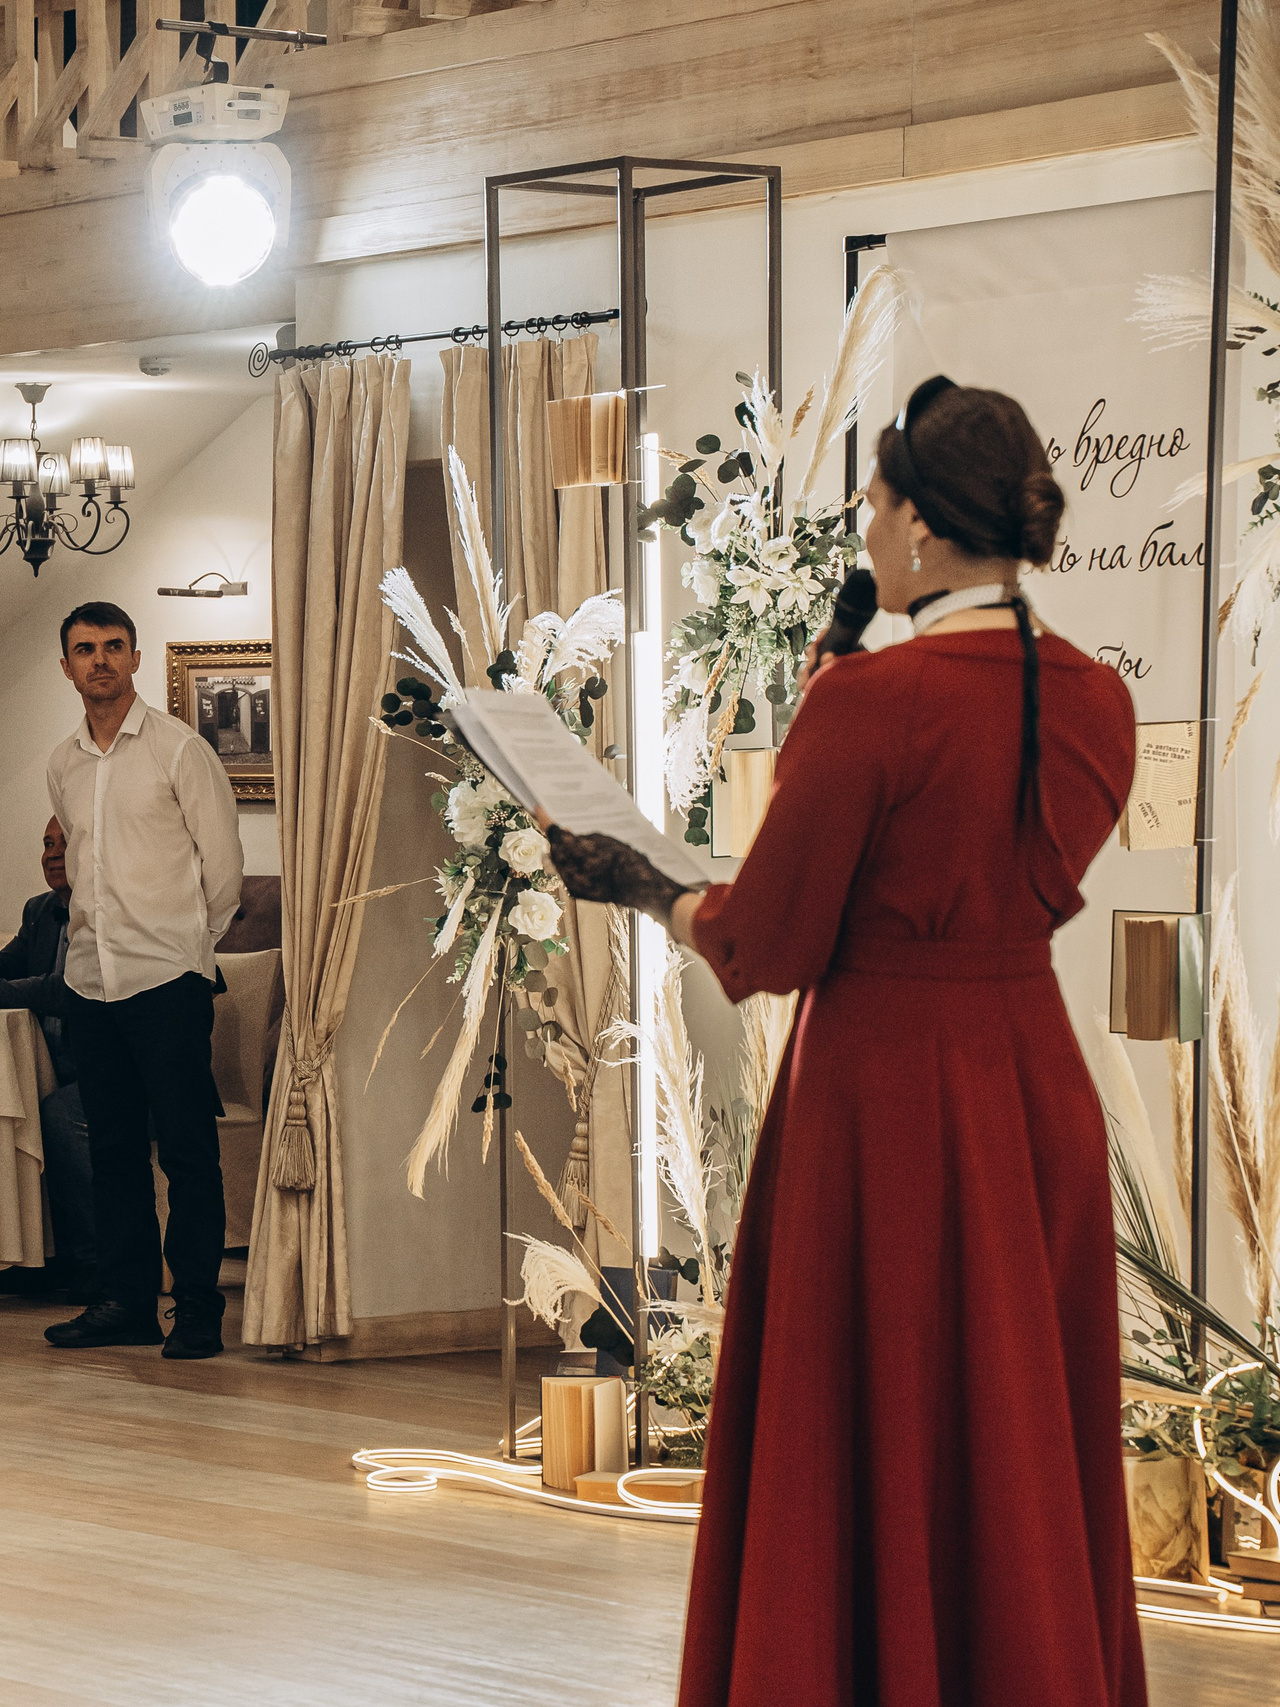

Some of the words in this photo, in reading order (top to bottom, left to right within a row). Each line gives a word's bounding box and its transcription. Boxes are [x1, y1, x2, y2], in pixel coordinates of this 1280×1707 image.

[1072, 398, 1191, 498] вредно
[1088, 544, 1132, 572] на
[1138, 519, 1205, 572] бал
